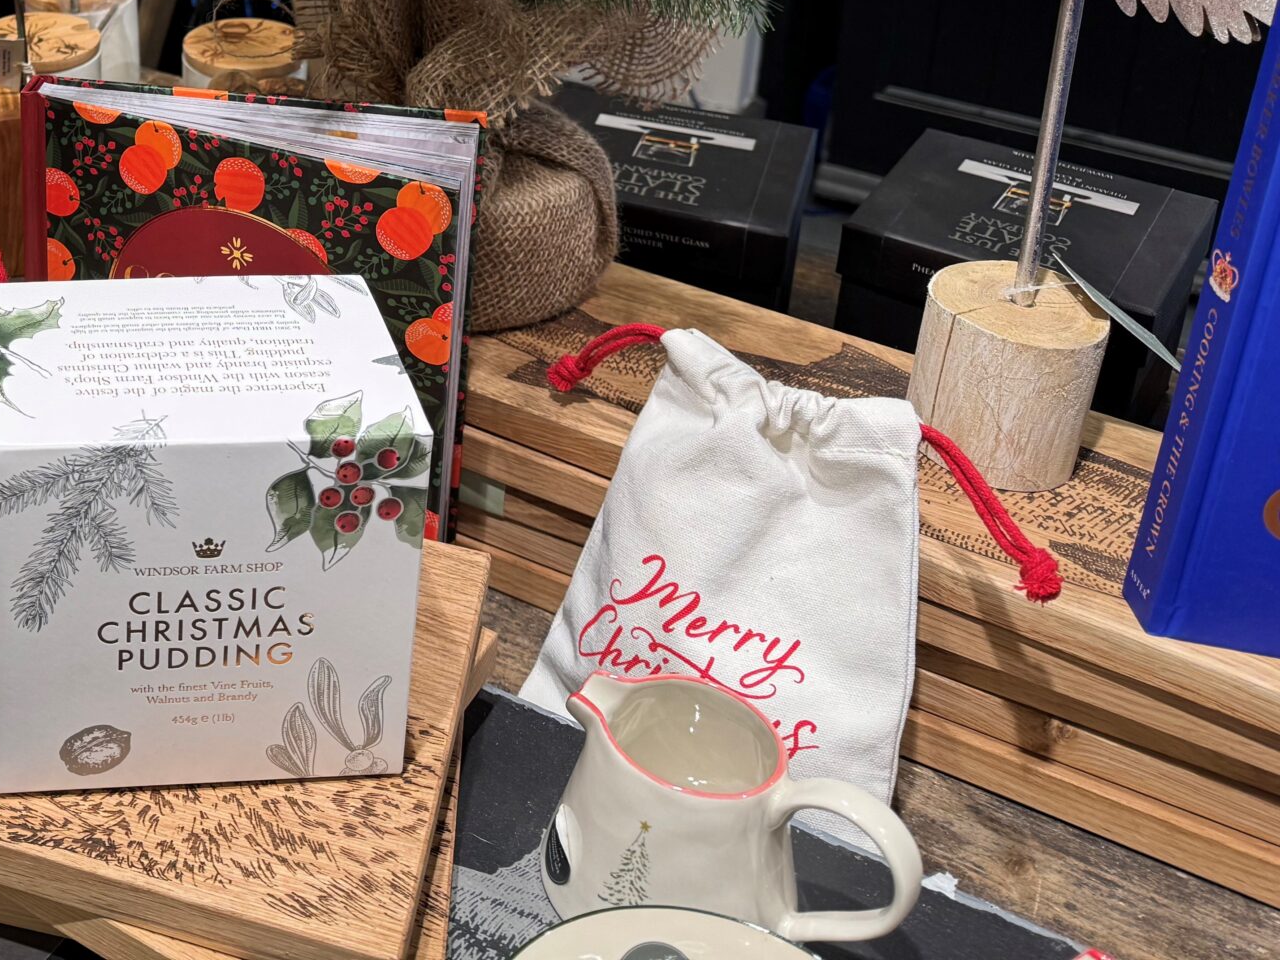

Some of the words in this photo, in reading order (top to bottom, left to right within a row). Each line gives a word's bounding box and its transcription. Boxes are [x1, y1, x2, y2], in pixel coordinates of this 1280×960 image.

[948, 232, 1004, 254] JUST
[65, 340, 165, 351] craftsmanship.
[168, 339, 194, 349] and
[200, 337, 247, 348] quality
[80, 353, 96, 363] of
[99, 351, 178, 362] celebration
[193, 351, 204, 359] is
[208, 351, 240, 360] This
[1183, 307, 1219, 411] COOKING
[57, 363, 129, 373] Christmas
[134, 362, 182, 372] walnut
[185, 361, 212, 371] and
[217, 359, 267, 370] brandy
[271, 357, 332, 369] exquisite
[158, 373, 220, 384] Windsor
[222, 372, 245, 382] the
[249, 371, 280, 382] with
[284, 370, 331, 378] season
[64, 374, 111, 386] Shop's
[114, 375, 155, 385] Farm
[124, 386, 146, 397] the
[151, 386, 167, 397] of
[170, 384, 214, 396] magic
[218, 384, 241, 395] the
[245, 381, 326, 393] Experience
[75, 388, 119, 399] festive
[1178, 411, 1191, 427] &
[1165, 436, 1185, 481] THE
[1144, 479, 1172, 559] CROWN
[133, 566, 200, 577] WINDSOR
[204, 563, 242, 575] FARM
[245, 561, 283, 573] SHOP
[128, 586, 286, 615] CLASSIC
[609, 554, 805, 689] Merry
[97, 612, 315, 644] CHRISTMAS
[117, 642, 293, 671] PUDDING
[130, 684, 154, 694] with
[157, 683, 175, 693] the
[178, 682, 208, 692] finest
[211, 681, 237, 691] Vine
[240, 679, 274, 690] Fruits,
[146, 694, 191, 705] Walnuts
[193, 693, 214, 703] and
[217, 691, 258, 703] Brandy
[171, 714, 198, 725] 454g
